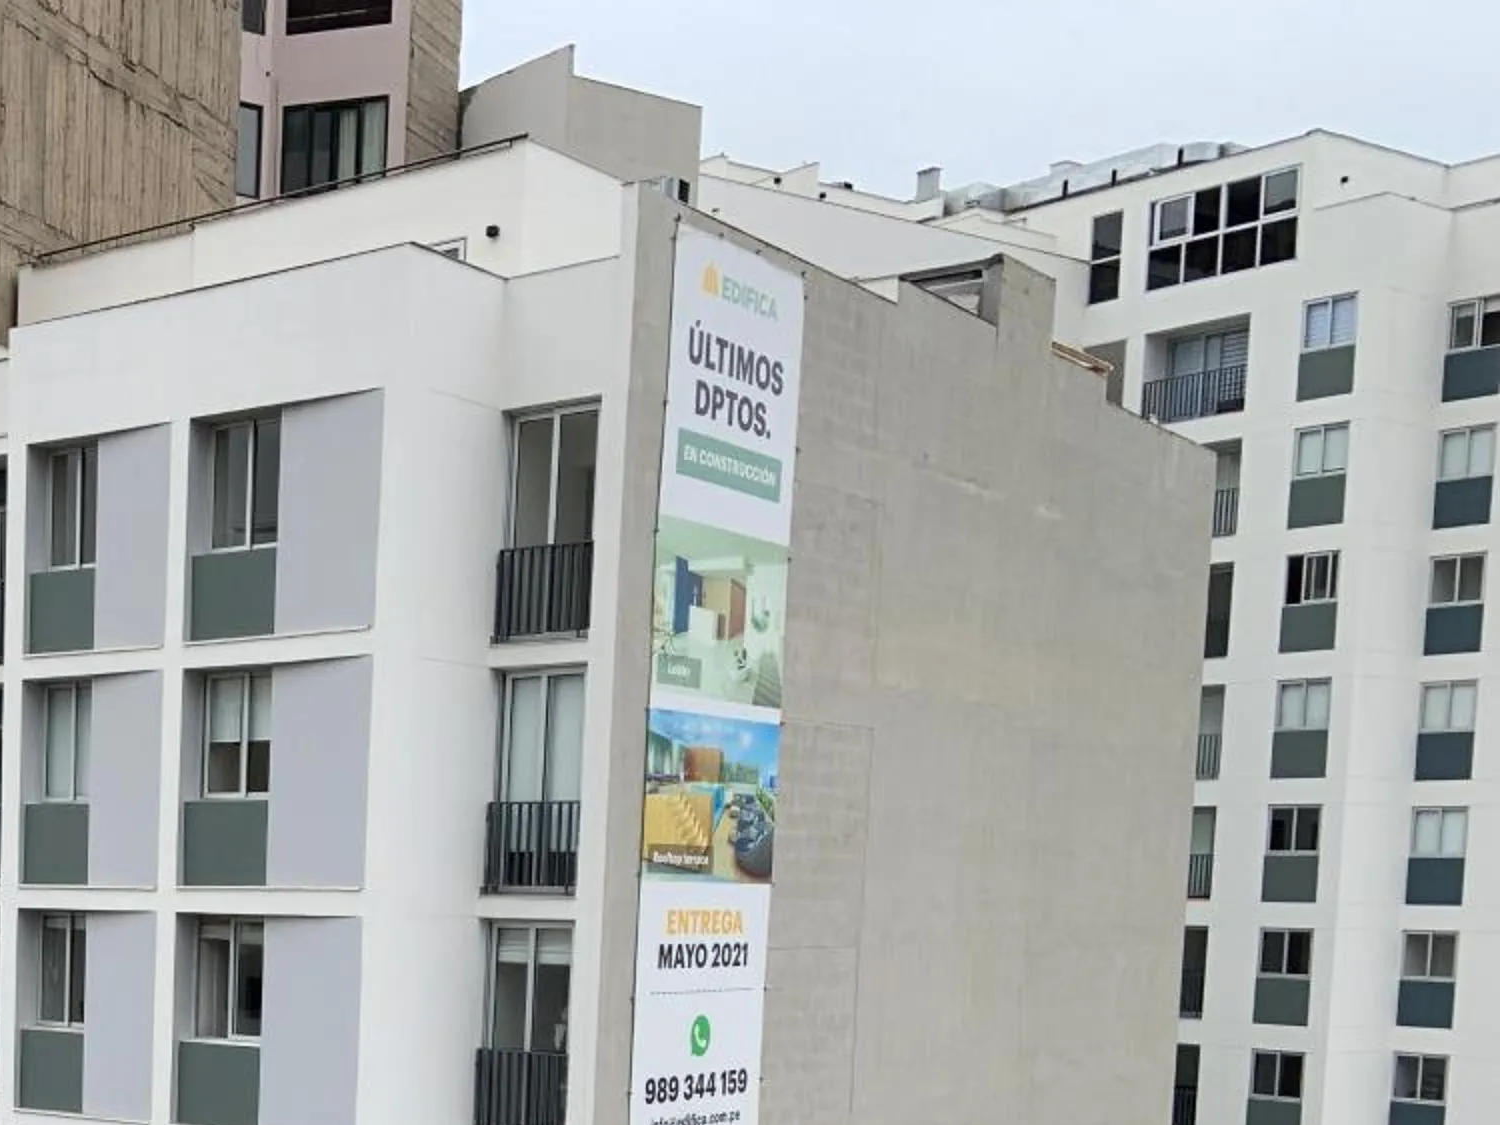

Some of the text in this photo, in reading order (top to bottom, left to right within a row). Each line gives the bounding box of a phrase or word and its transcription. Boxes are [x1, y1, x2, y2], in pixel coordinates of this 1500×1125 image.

[722, 277, 779, 321] EDIFICA
[688, 319, 784, 396] ÚLTIMOS
[695, 379, 771, 439] DPTOS.
[683, 444, 776, 486] EN CONSTRUCCIÓN
[666, 909, 743, 935] ENTREGA
[657, 942, 749, 969] MAYO 2021
[645, 1067, 748, 1105] 989 344 159
